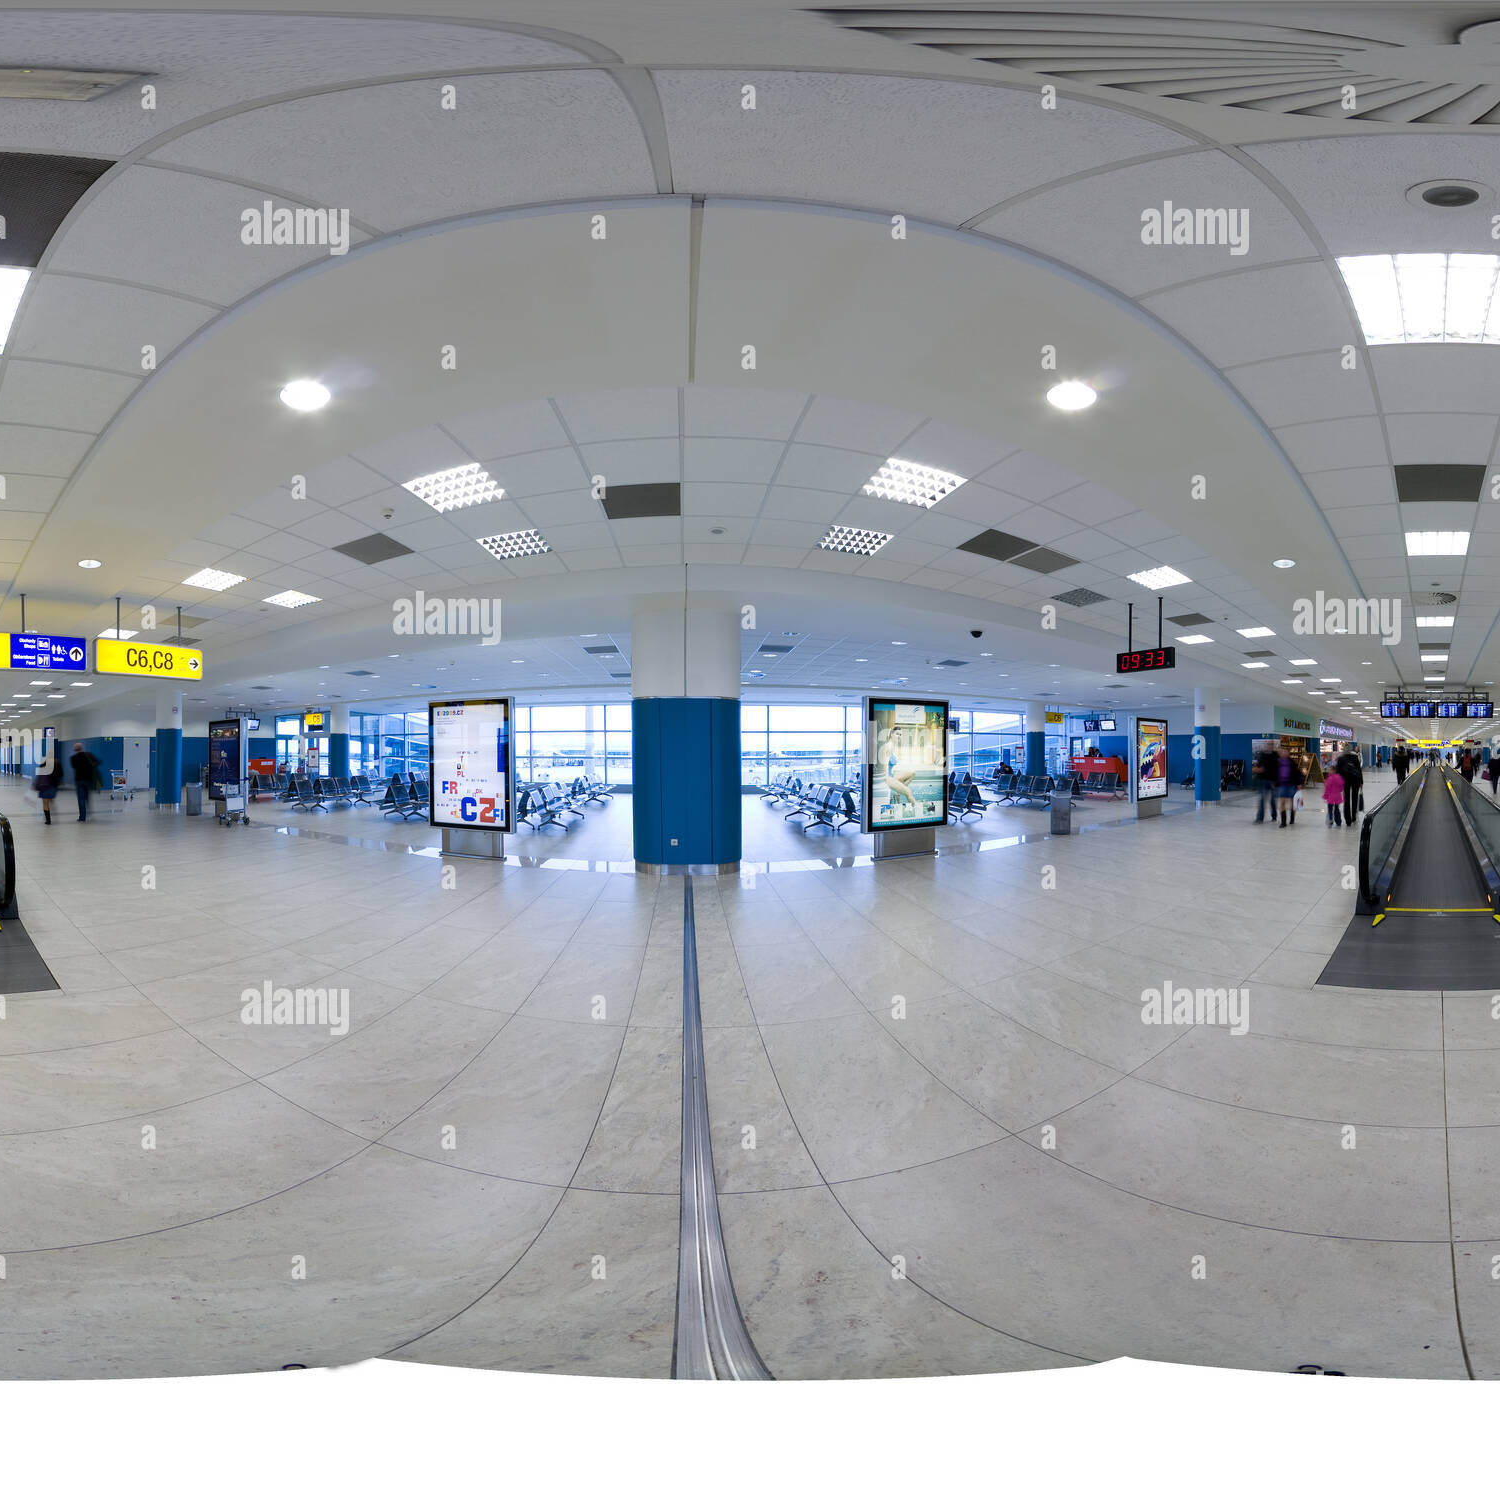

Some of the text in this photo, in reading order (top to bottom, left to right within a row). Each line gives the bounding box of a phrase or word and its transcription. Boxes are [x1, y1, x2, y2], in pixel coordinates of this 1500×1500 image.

[127, 648, 174, 672] C6,C8
[1121, 650, 1165, 671] 09:33
[442, 780, 458, 794] FR
[461, 796, 496, 823] CZ
